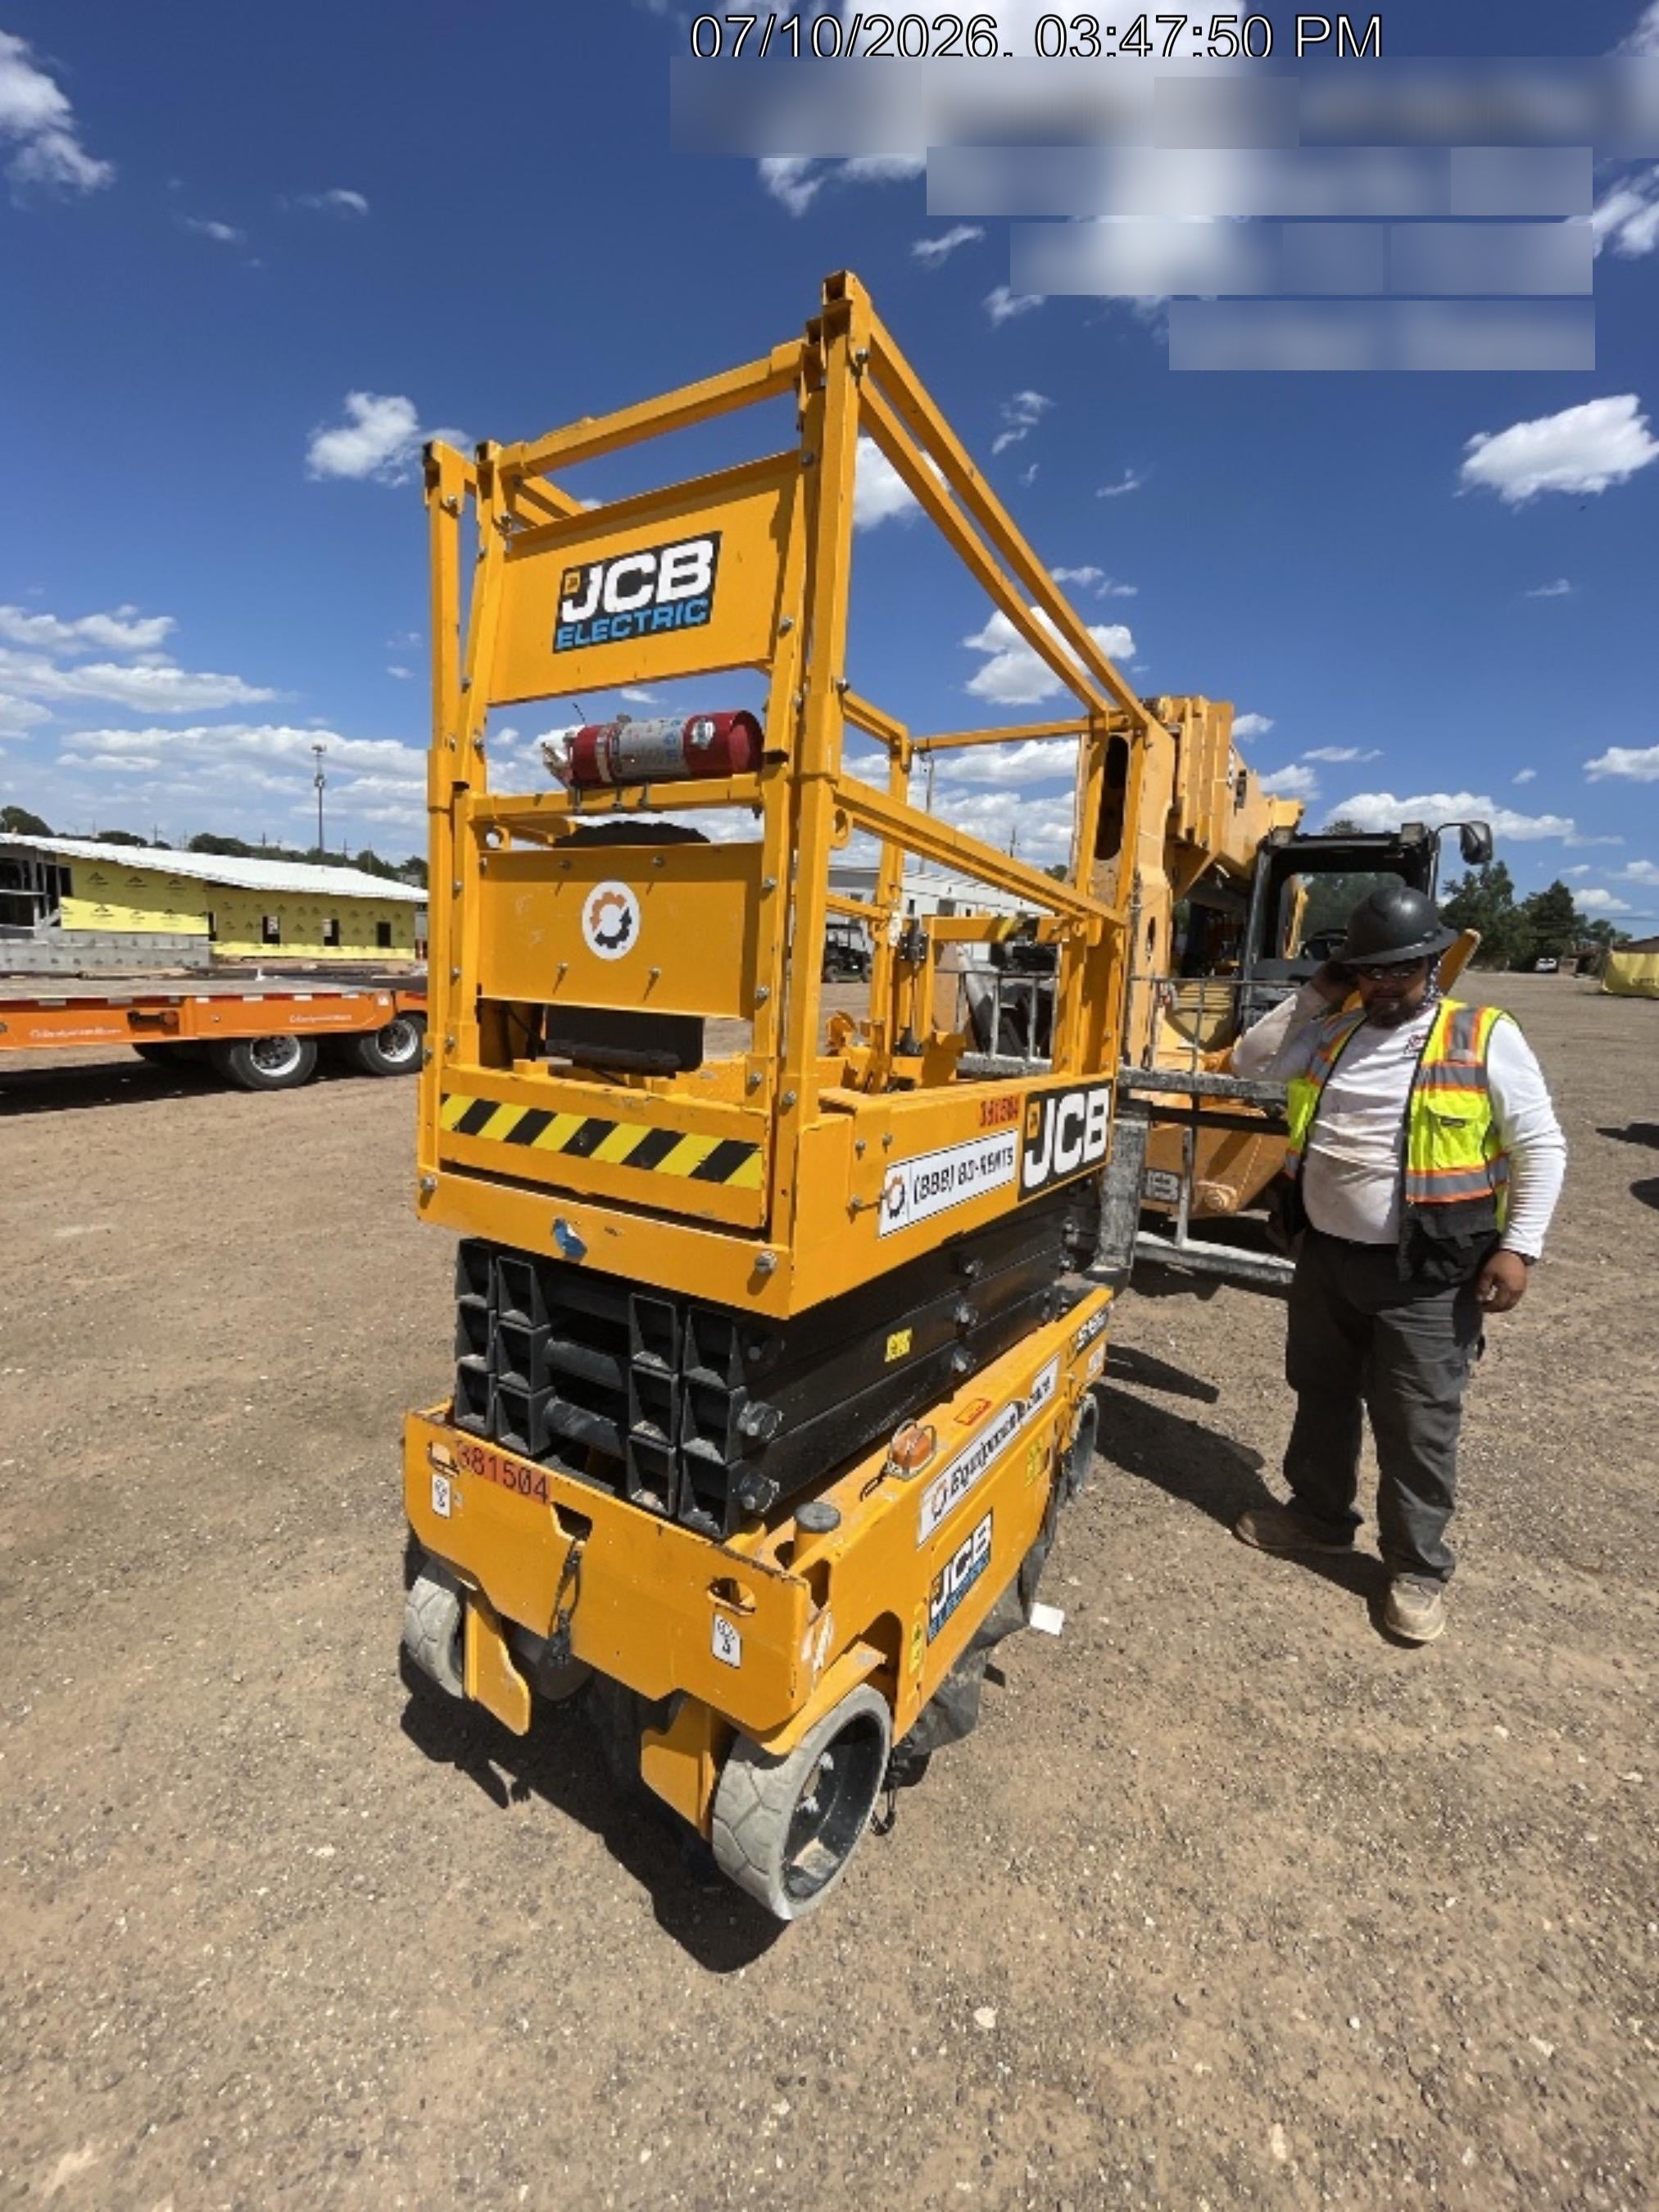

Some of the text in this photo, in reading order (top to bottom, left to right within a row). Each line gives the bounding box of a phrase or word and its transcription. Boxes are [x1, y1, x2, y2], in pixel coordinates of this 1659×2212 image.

[562, 540, 714, 623] JCB
[555, 597, 709, 650] ELECTRIC
[1024, 1088, 1110, 1188] JCB
[455, 1439, 549, 1504] 381504
[930, 1513, 992, 1620] JCB
